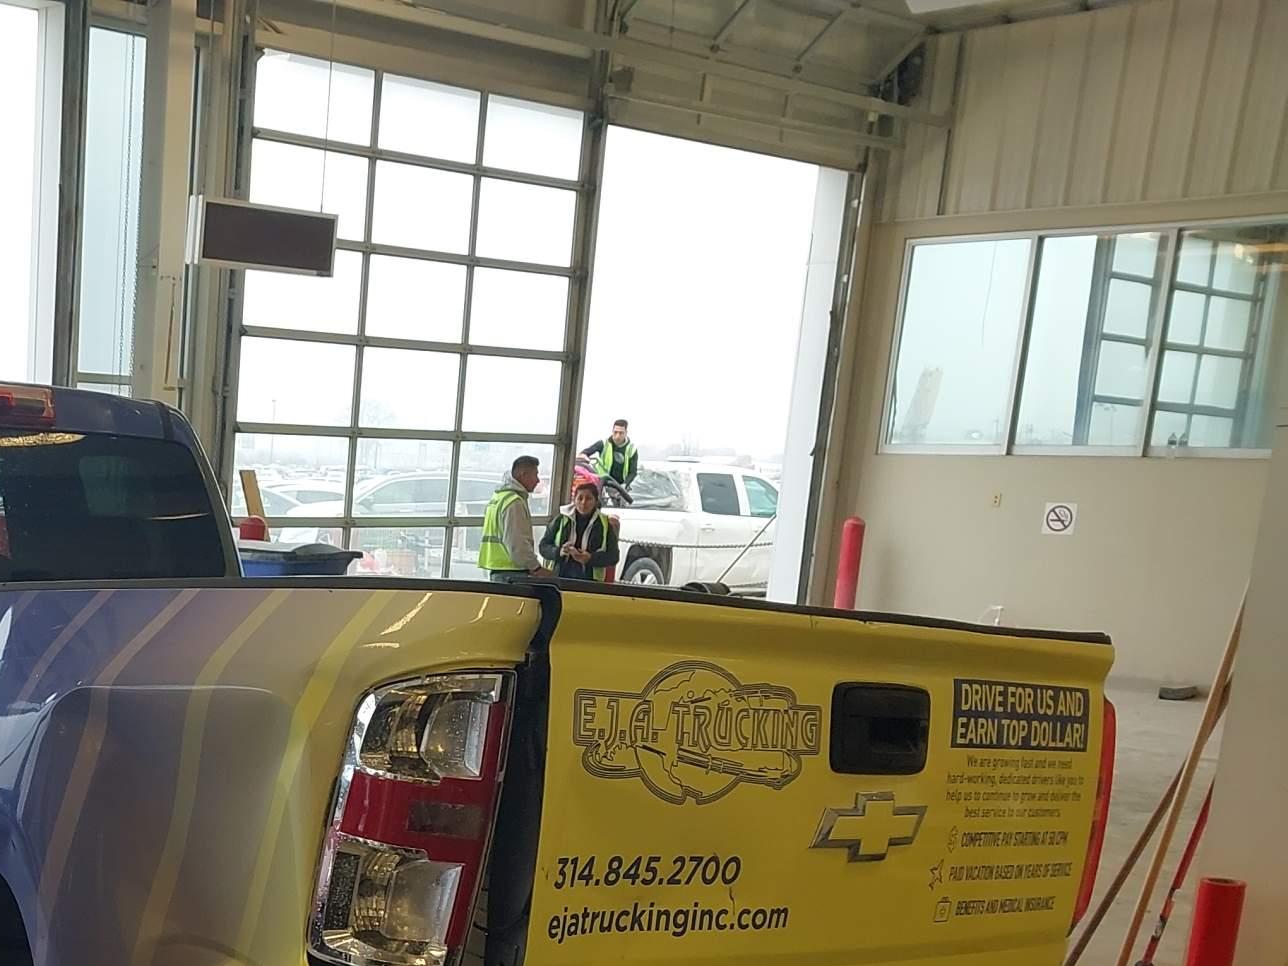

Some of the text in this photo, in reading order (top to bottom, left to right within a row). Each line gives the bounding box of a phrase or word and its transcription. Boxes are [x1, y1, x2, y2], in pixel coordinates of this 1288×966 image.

[961, 683, 1084, 717] DRIVE FOR US AND
[577, 695, 820, 753] E.J.A. TRUCKING
[956, 716, 1085, 748] EARN TOP DOLLAR!
[966, 755, 978, 768] We
[979, 759, 992, 768] are
[992, 758, 1020, 771] growing
[1021, 756, 1033, 769] fast
[1034, 757, 1047, 769] and
[999, 772, 1031, 785] dedicated
[1032, 773, 1054, 785] drivers
[946, 788, 963, 804] help
[963, 791, 973, 801] us
[974, 791, 981, 801] to
[982, 790, 1011, 801] continue
[1021, 792, 1037, 804] grow
[1037, 790, 1049, 802] and
[964, 806, 980, 818] best
[981, 807, 1006, 818] service
[960, 831, 1001, 848] COMPETITIVE
[1001, 831, 1012, 847] PAY
[1013, 831, 1040, 847] STARTING
[553, 854, 742, 889] 314.845.2700
[948, 865, 965, 881] PAID
[965, 864, 994, 880] VACATION
[994, 864, 1014, 880] BASED
[1014, 864, 1024, 879] ON
[1024, 863, 1043, 879] YEARS
[1050, 862, 1072, 878] SERVICE
[955, 896, 1056, 916] BENEFITS AND MEDICAL INSURANCE
[547, 902, 789, 944] ejatruckinginc.com
